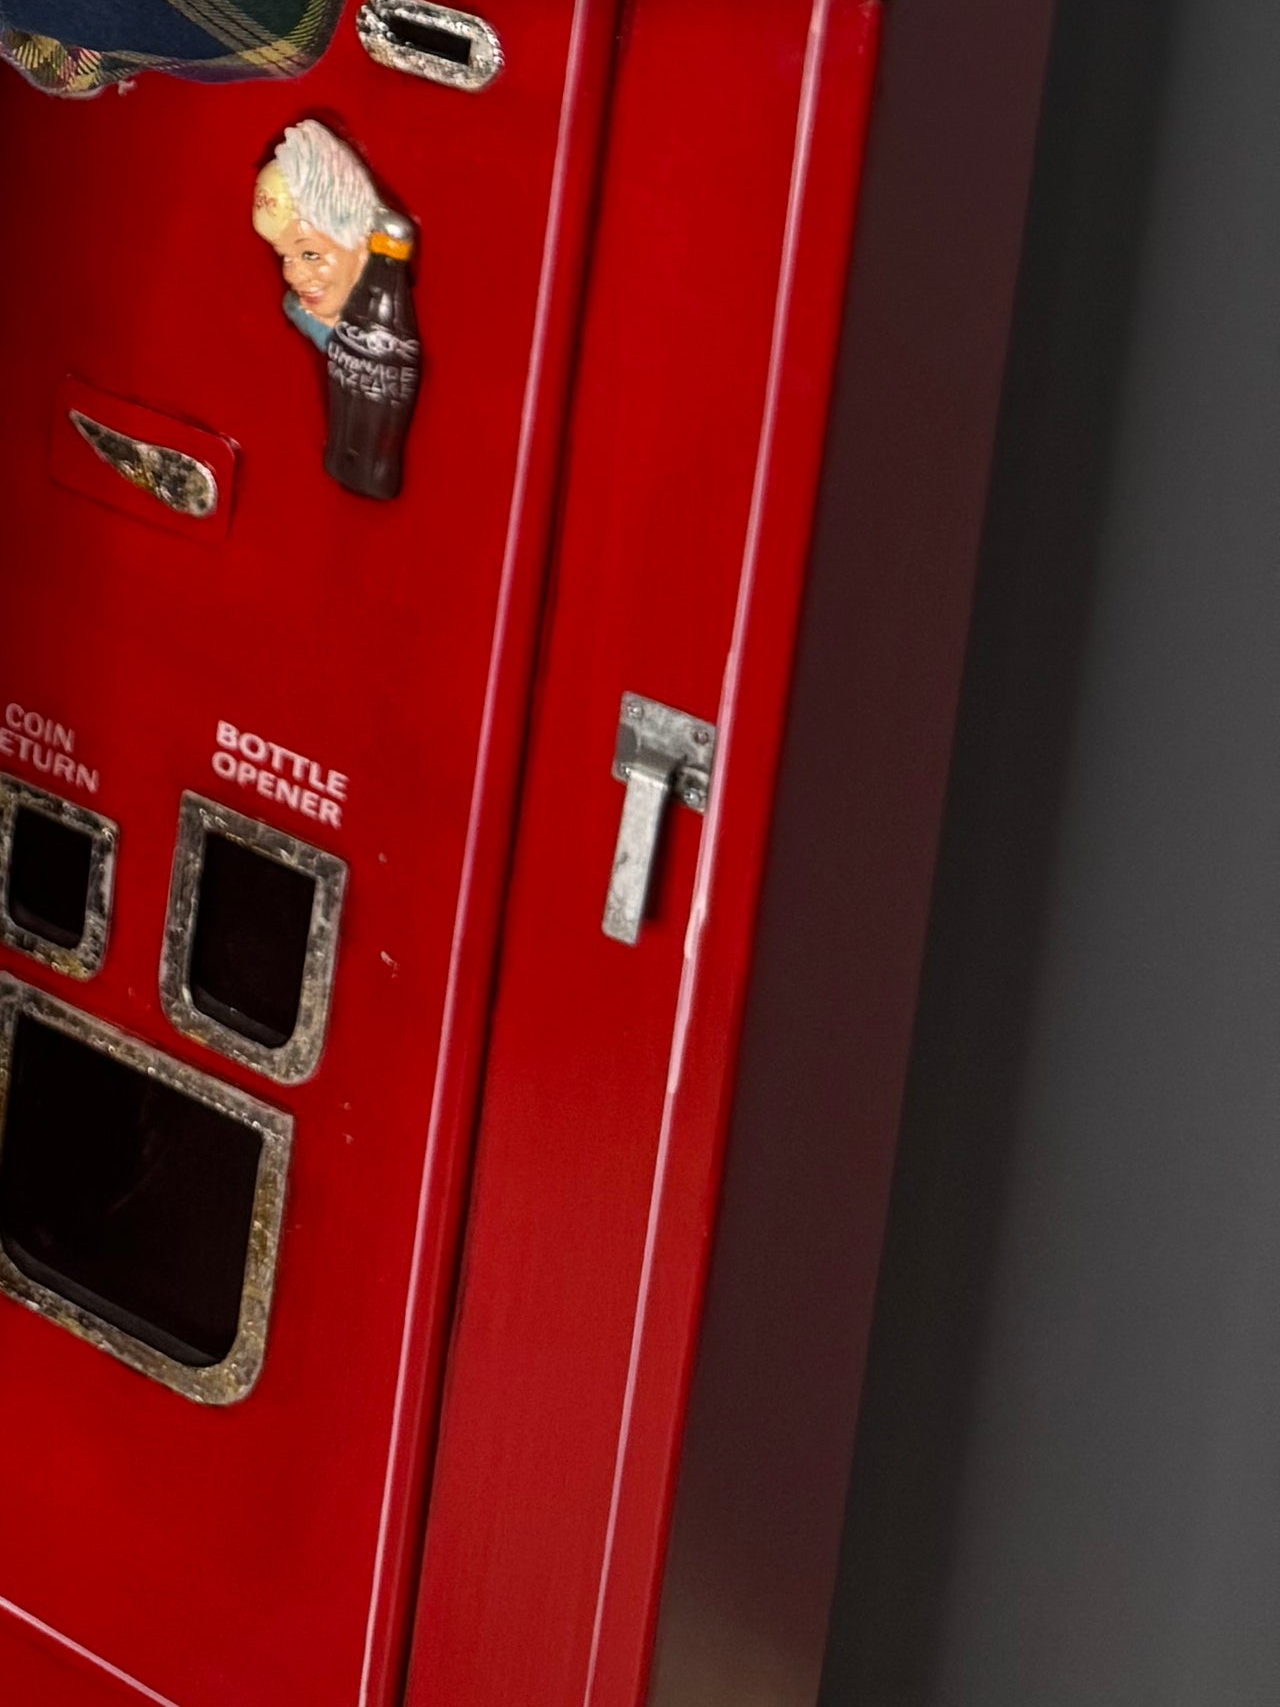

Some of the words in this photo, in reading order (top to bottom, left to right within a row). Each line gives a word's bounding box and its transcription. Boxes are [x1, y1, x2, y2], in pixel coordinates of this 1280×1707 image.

[5, 702, 76, 754] COIN
[216, 719, 349, 802] BOTTLE
[211, 750, 343, 829] OPENER
